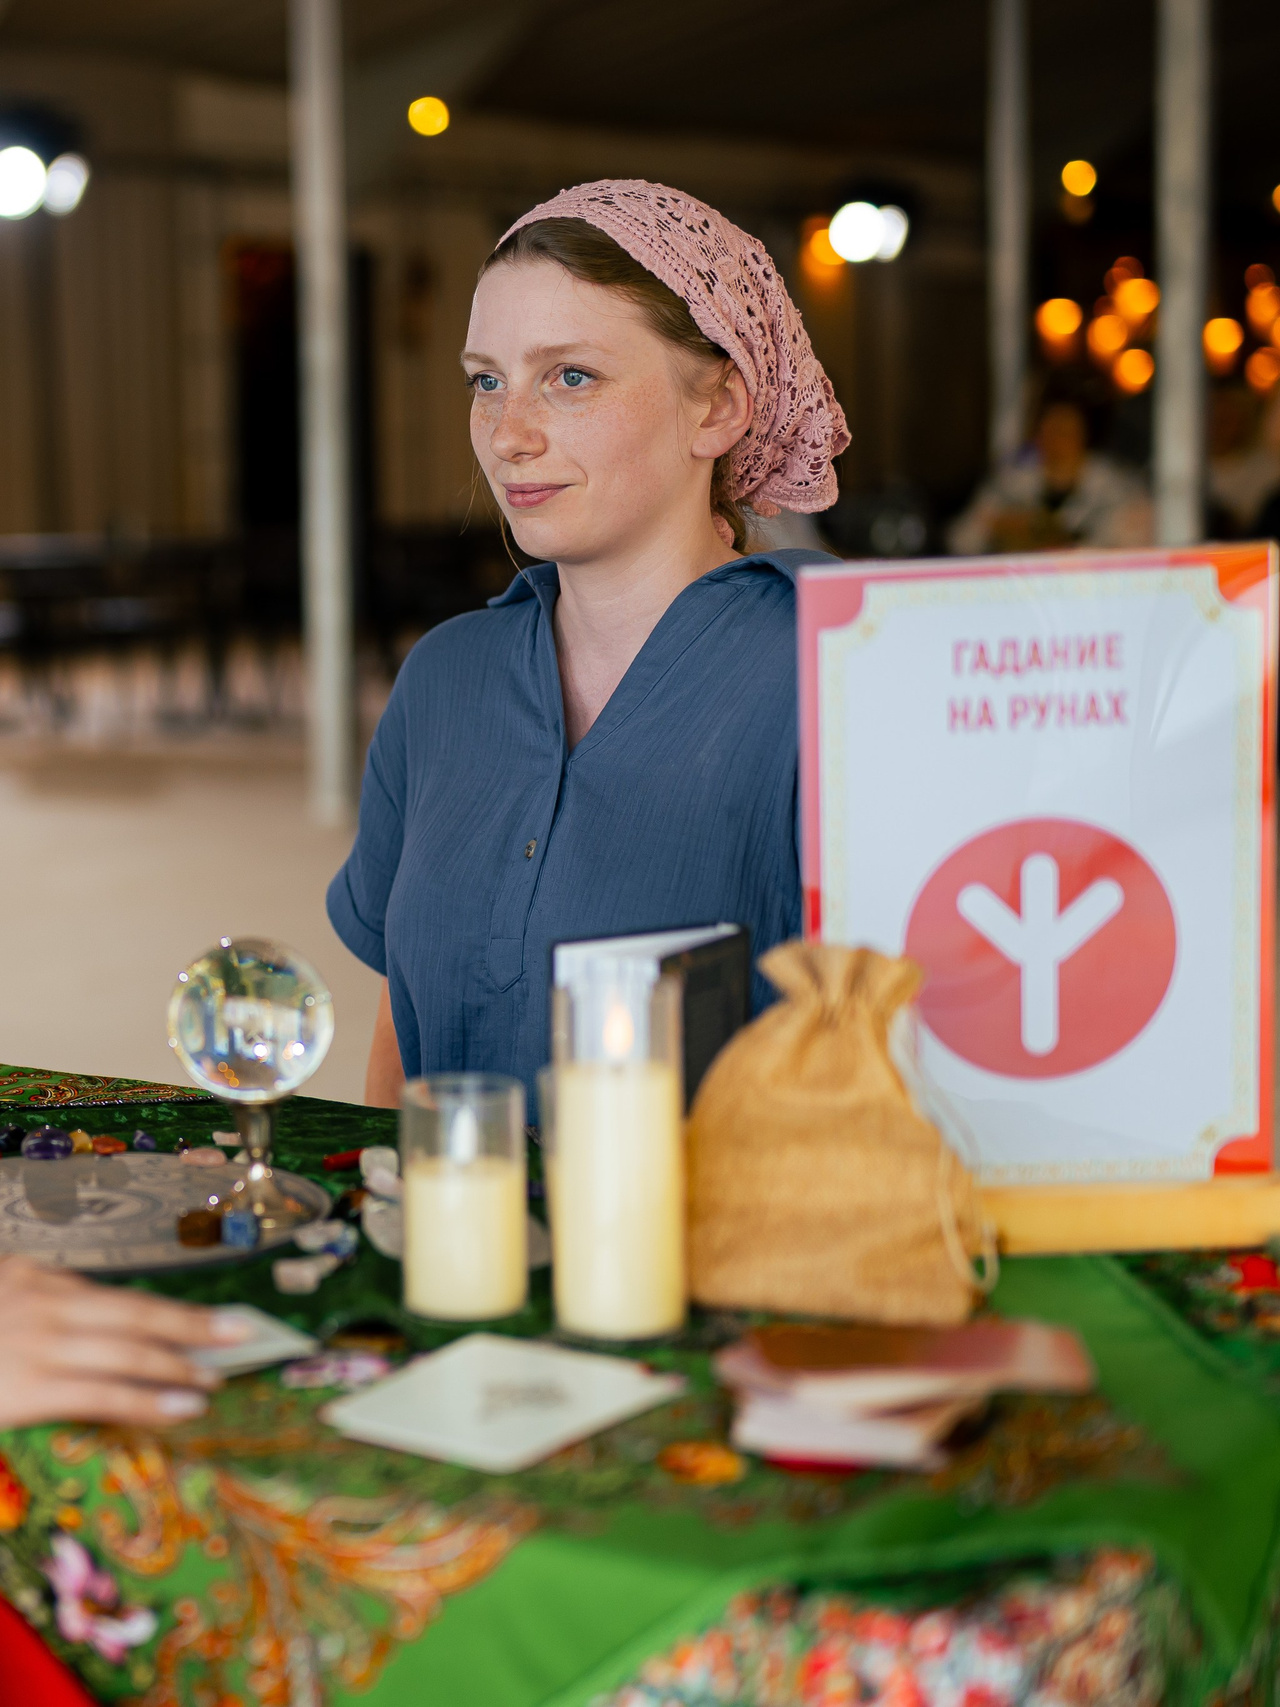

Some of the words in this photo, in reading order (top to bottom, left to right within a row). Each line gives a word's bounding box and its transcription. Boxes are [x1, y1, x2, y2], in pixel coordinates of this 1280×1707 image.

[951, 633, 1124, 679] ГАДАНИЕ
[947, 696, 997, 733] НА
[1008, 689, 1129, 730] РУНАХ
